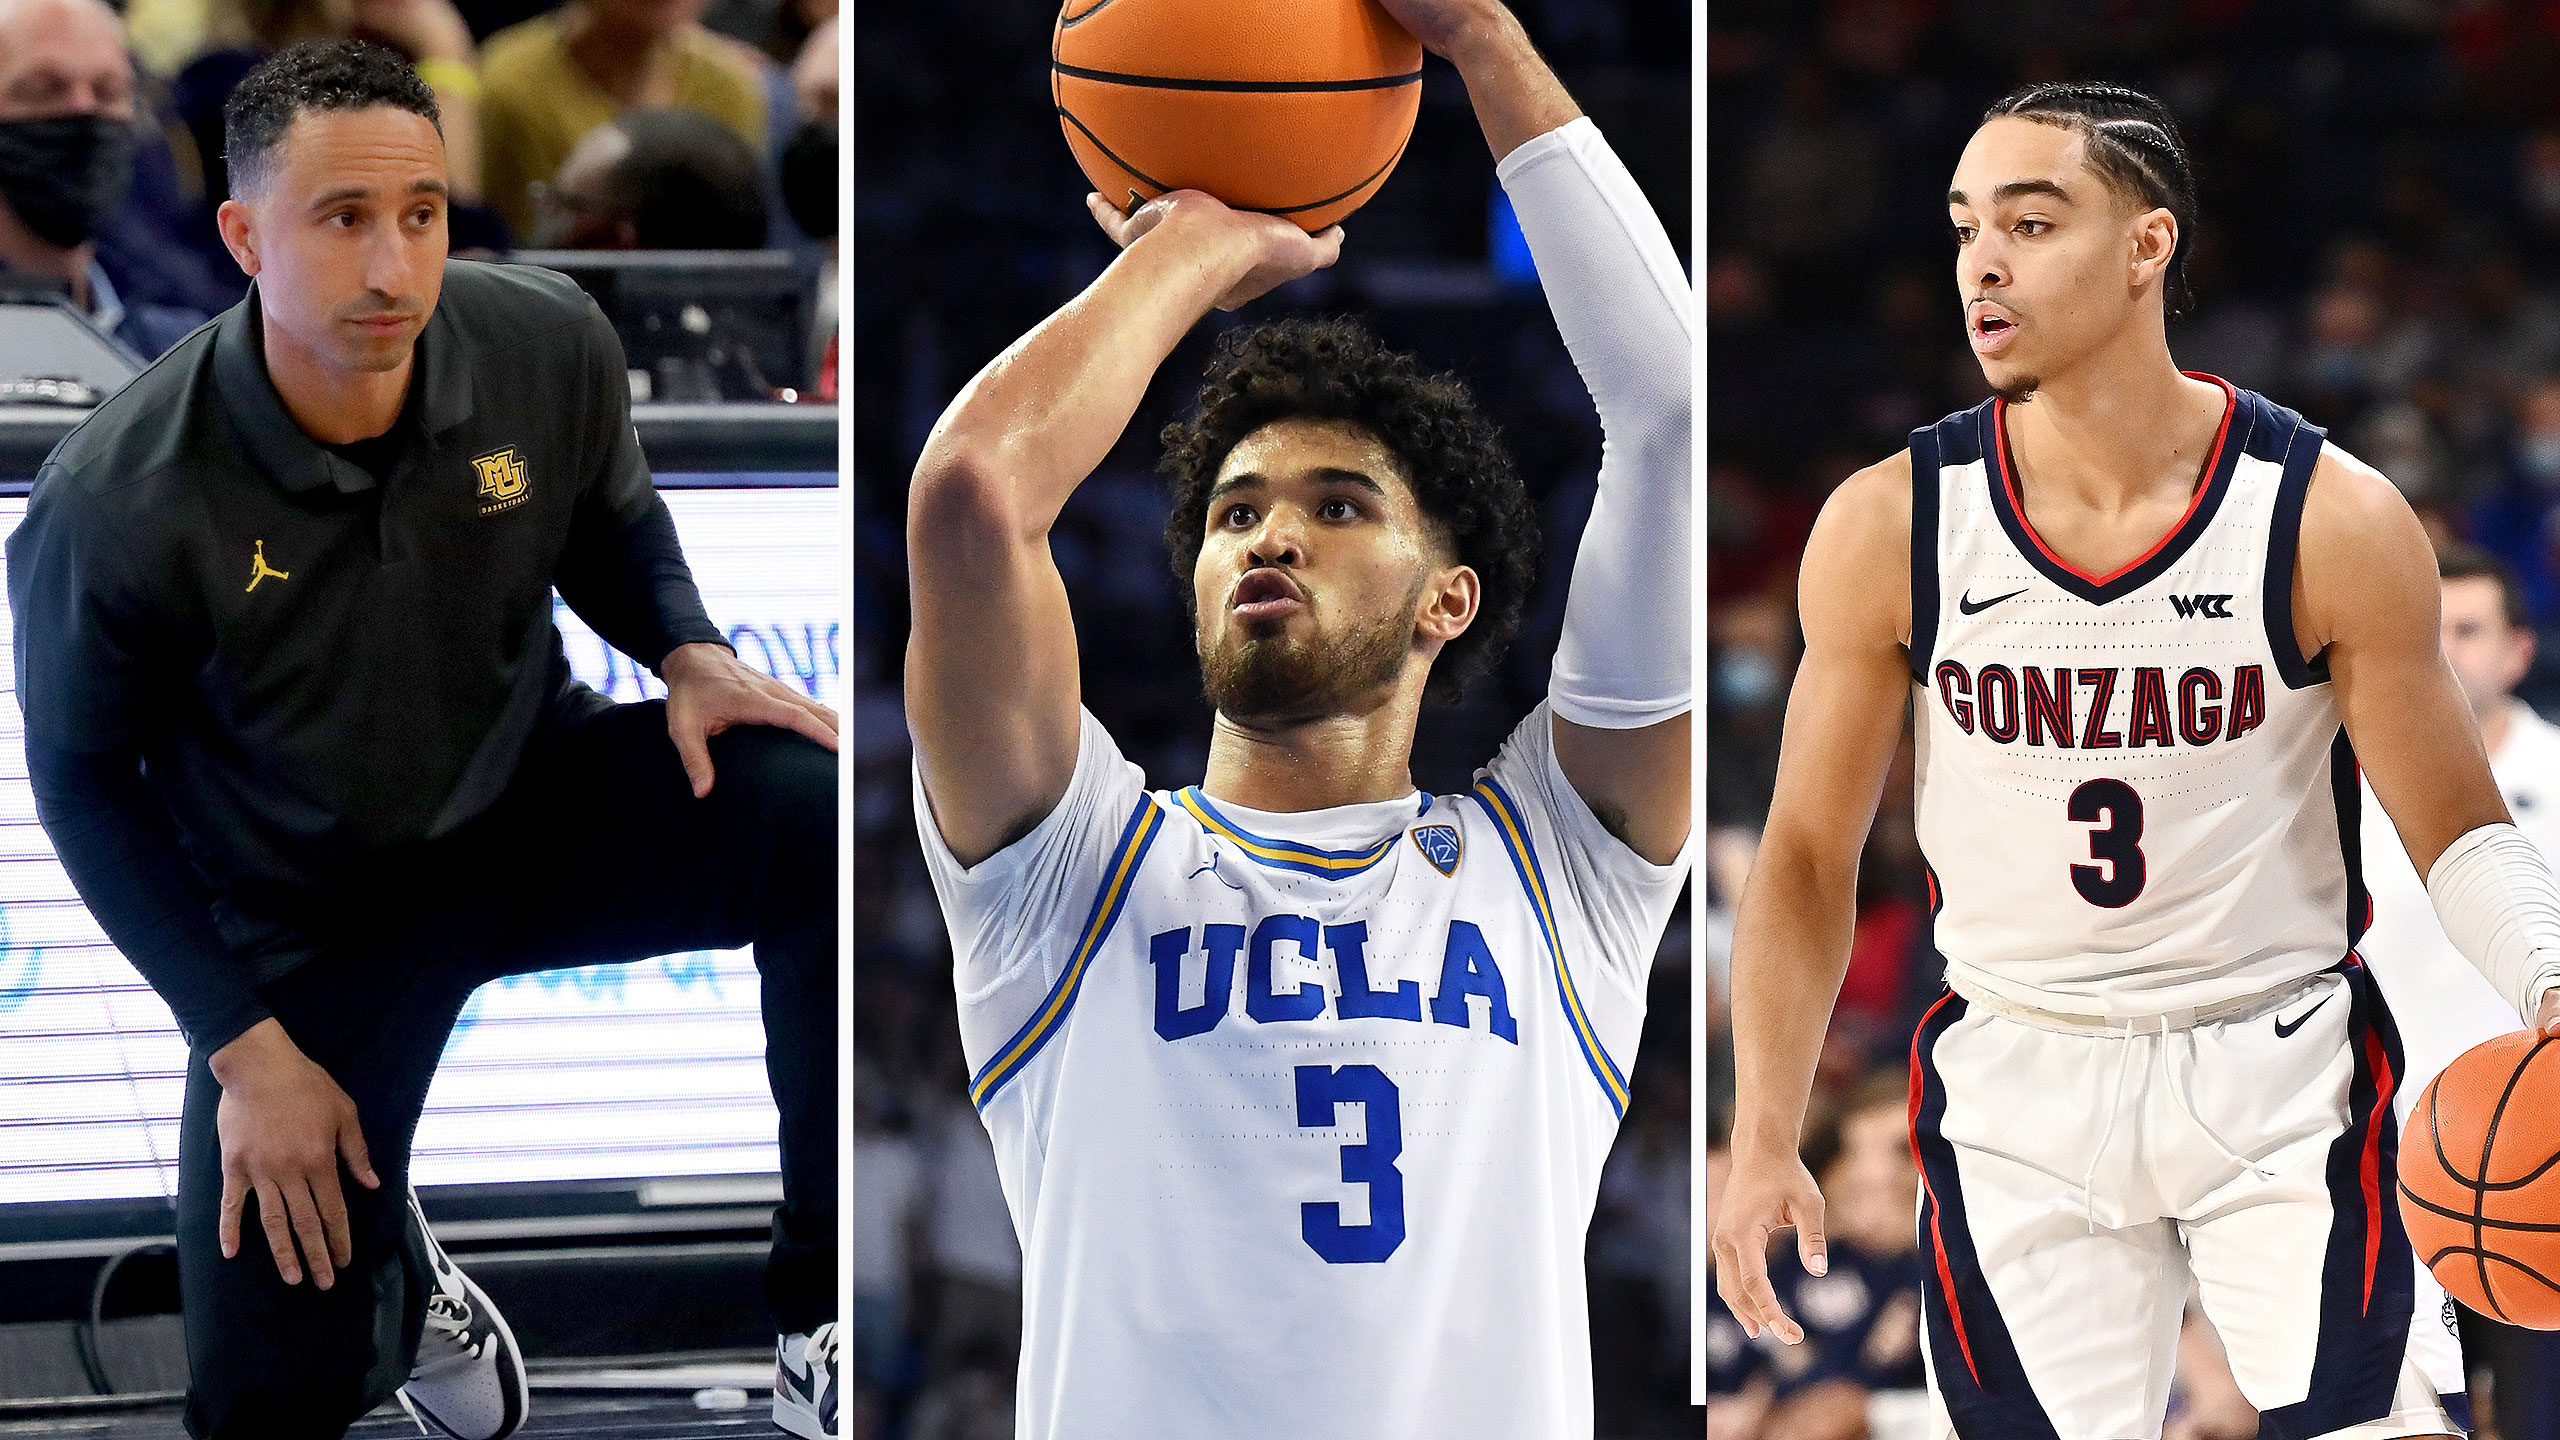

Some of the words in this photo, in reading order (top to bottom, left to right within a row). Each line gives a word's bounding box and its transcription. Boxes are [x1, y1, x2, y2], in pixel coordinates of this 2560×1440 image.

[473, 451, 526, 499] MU
[481, 493, 529, 514] BASKETBALL
[2168, 594, 2234, 620] WCC
[1936, 659, 2266, 749] GONZAGA
[1413, 827, 1459, 855] PAC
[1430, 844, 1454, 864] 12
[2068, 777, 2147, 909] 3
[1150, 914, 1518, 1046] UCLA
[1294, 1064, 1406, 1264] 3
